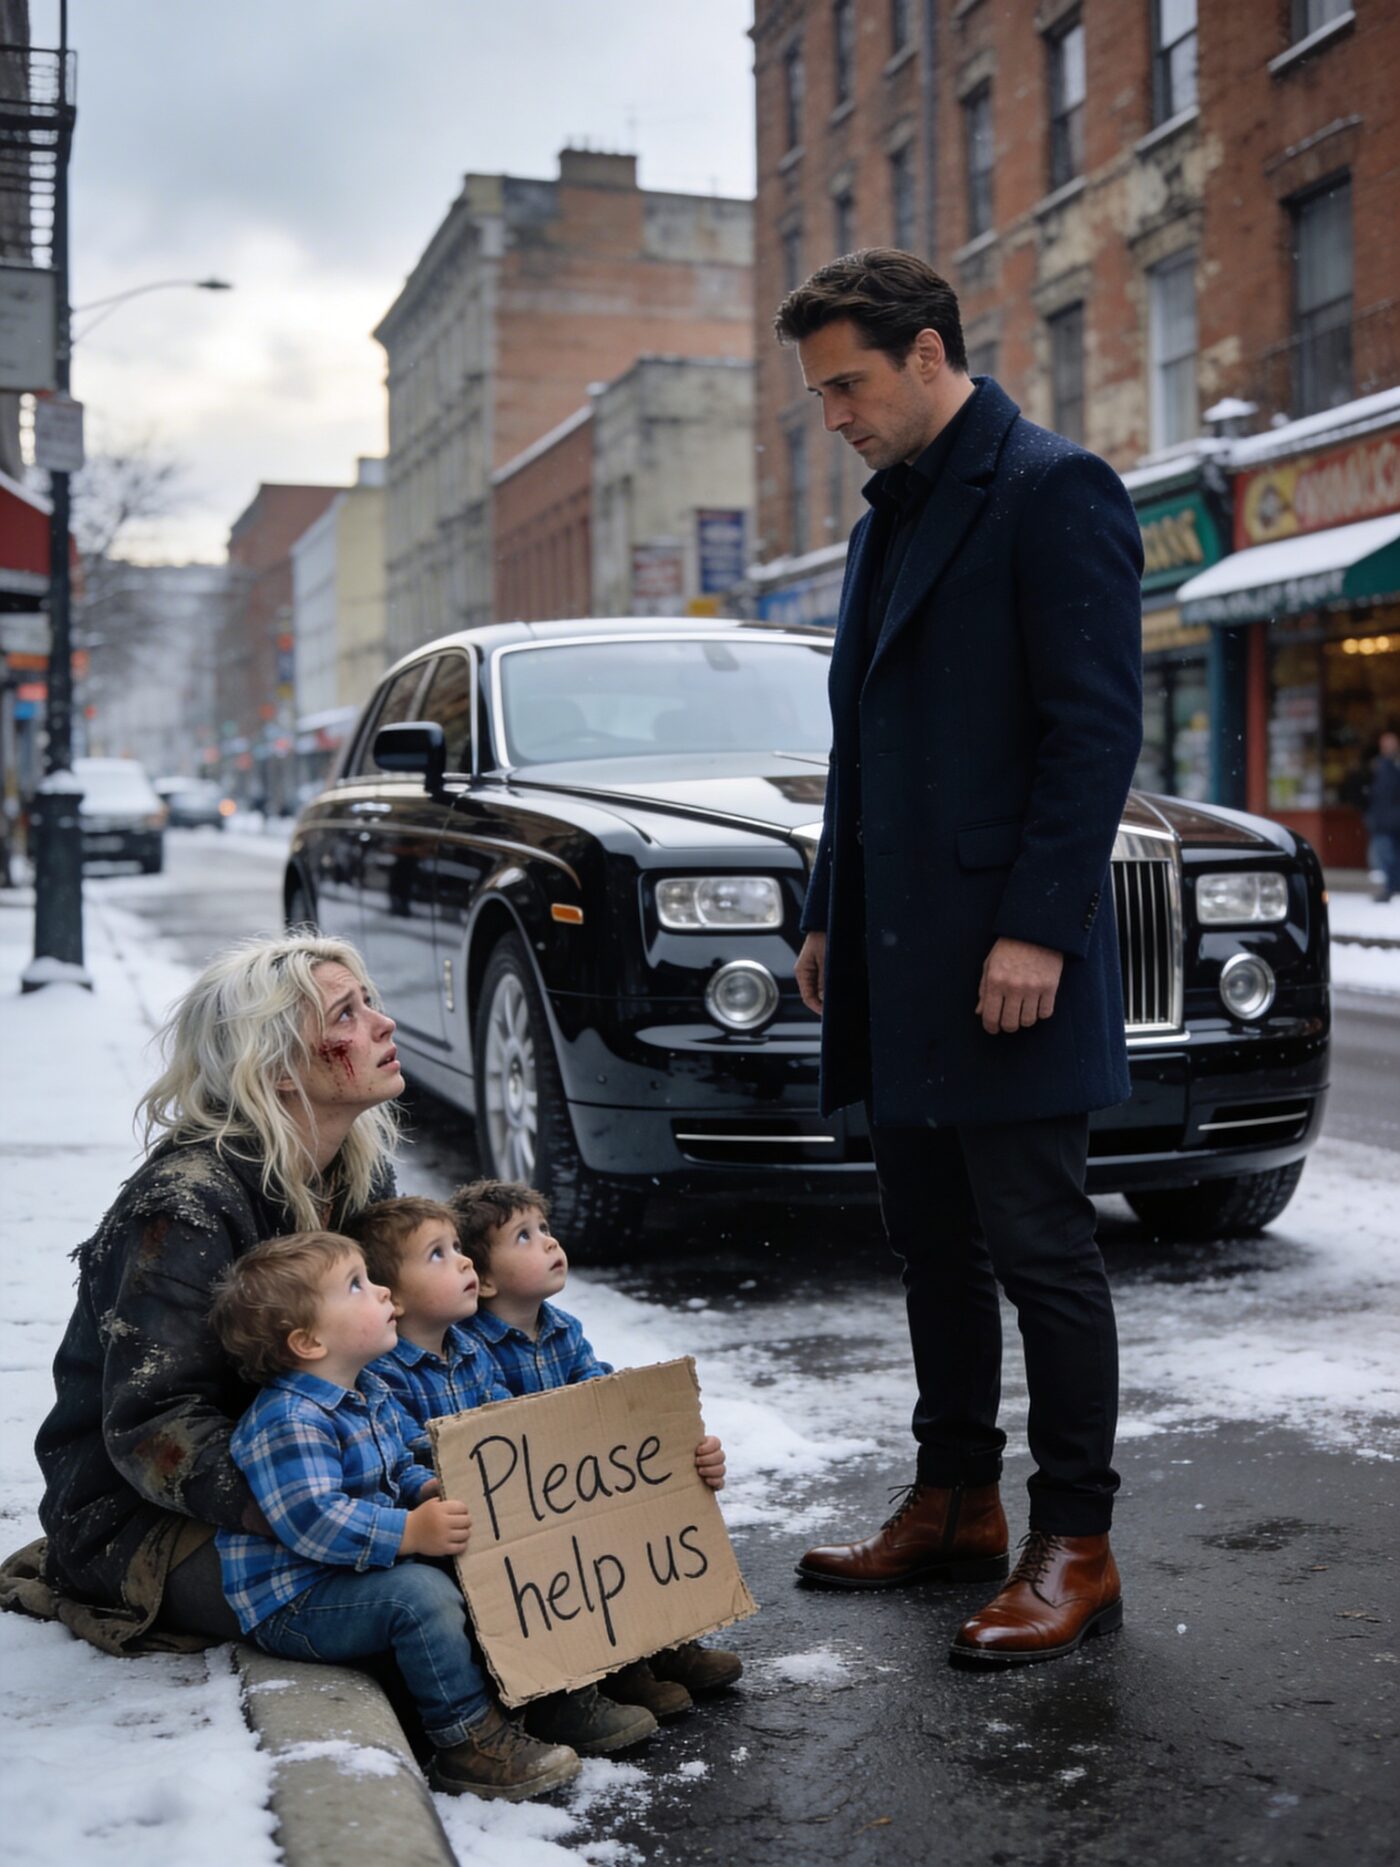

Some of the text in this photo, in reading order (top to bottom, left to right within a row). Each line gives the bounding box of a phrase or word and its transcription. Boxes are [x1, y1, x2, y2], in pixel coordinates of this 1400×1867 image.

[469, 1434, 672, 1540] Please
[504, 1525, 708, 1647] help us
